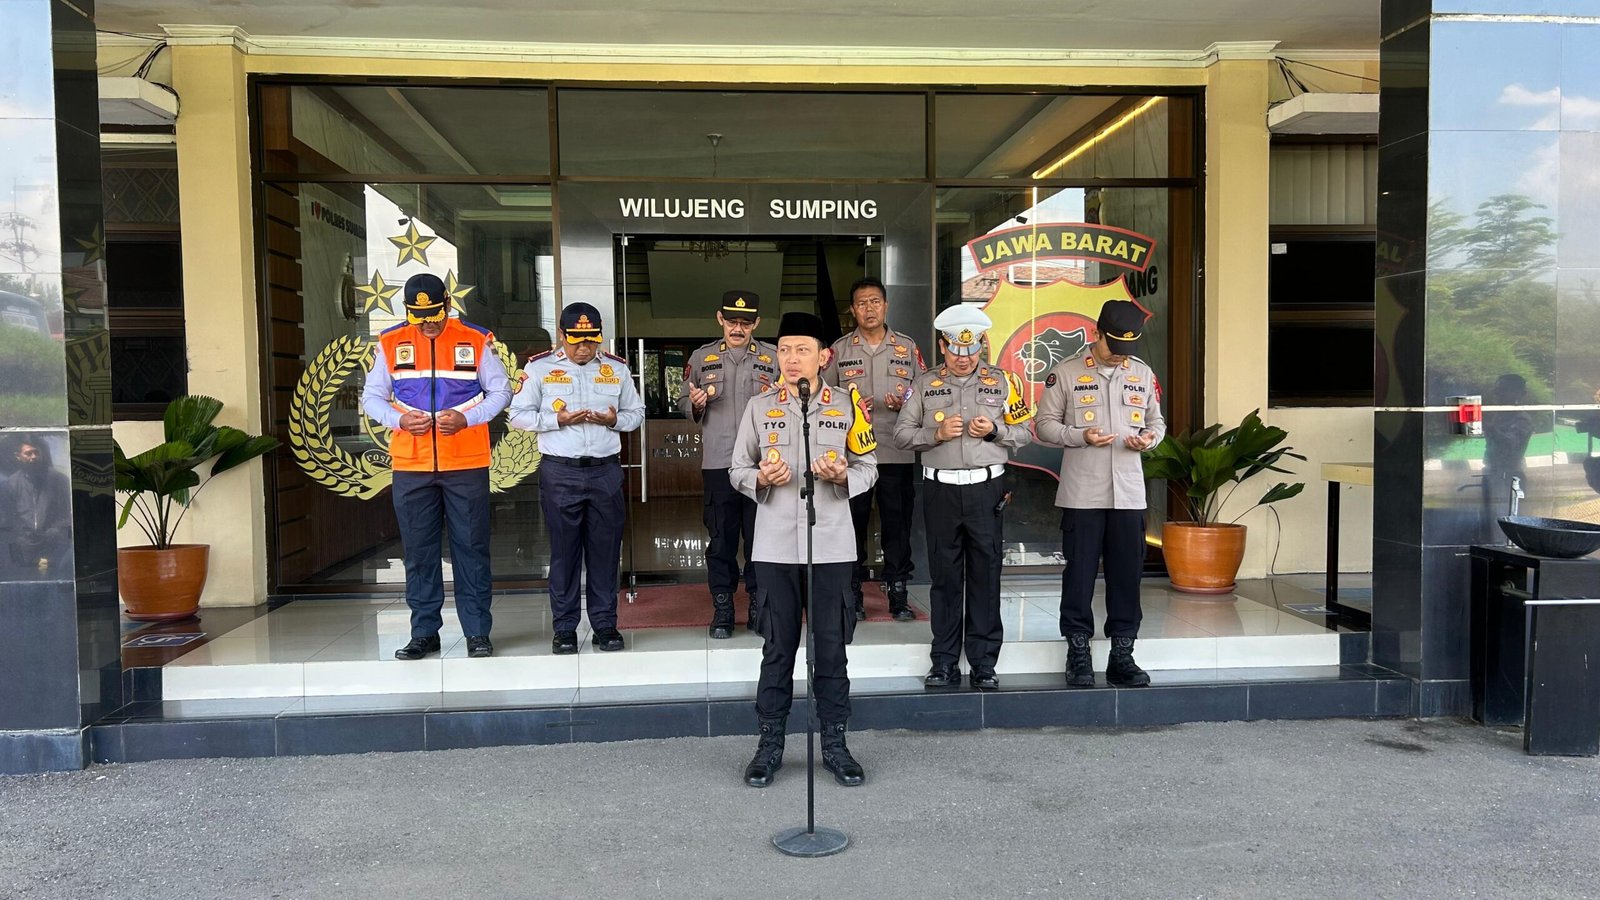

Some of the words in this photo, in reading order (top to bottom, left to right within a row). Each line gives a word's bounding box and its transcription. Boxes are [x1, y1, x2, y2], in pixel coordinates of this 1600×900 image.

[619, 198, 745, 219] WILUJENG
[769, 199, 878, 219] SUMPING
[980, 233, 1053, 264] JAWA
[1061, 232, 1147, 263] BARAT
[890, 359, 912, 367] POLRI
[753, 363, 774, 374] POLRI
[978, 387, 1002, 396] POLRI
[1074, 384, 1099, 392] AWANG
[1123, 384, 1146, 393] POLRI
[763, 421, 786, 430] TYO
[818, 420, 848, 431] POLRI
